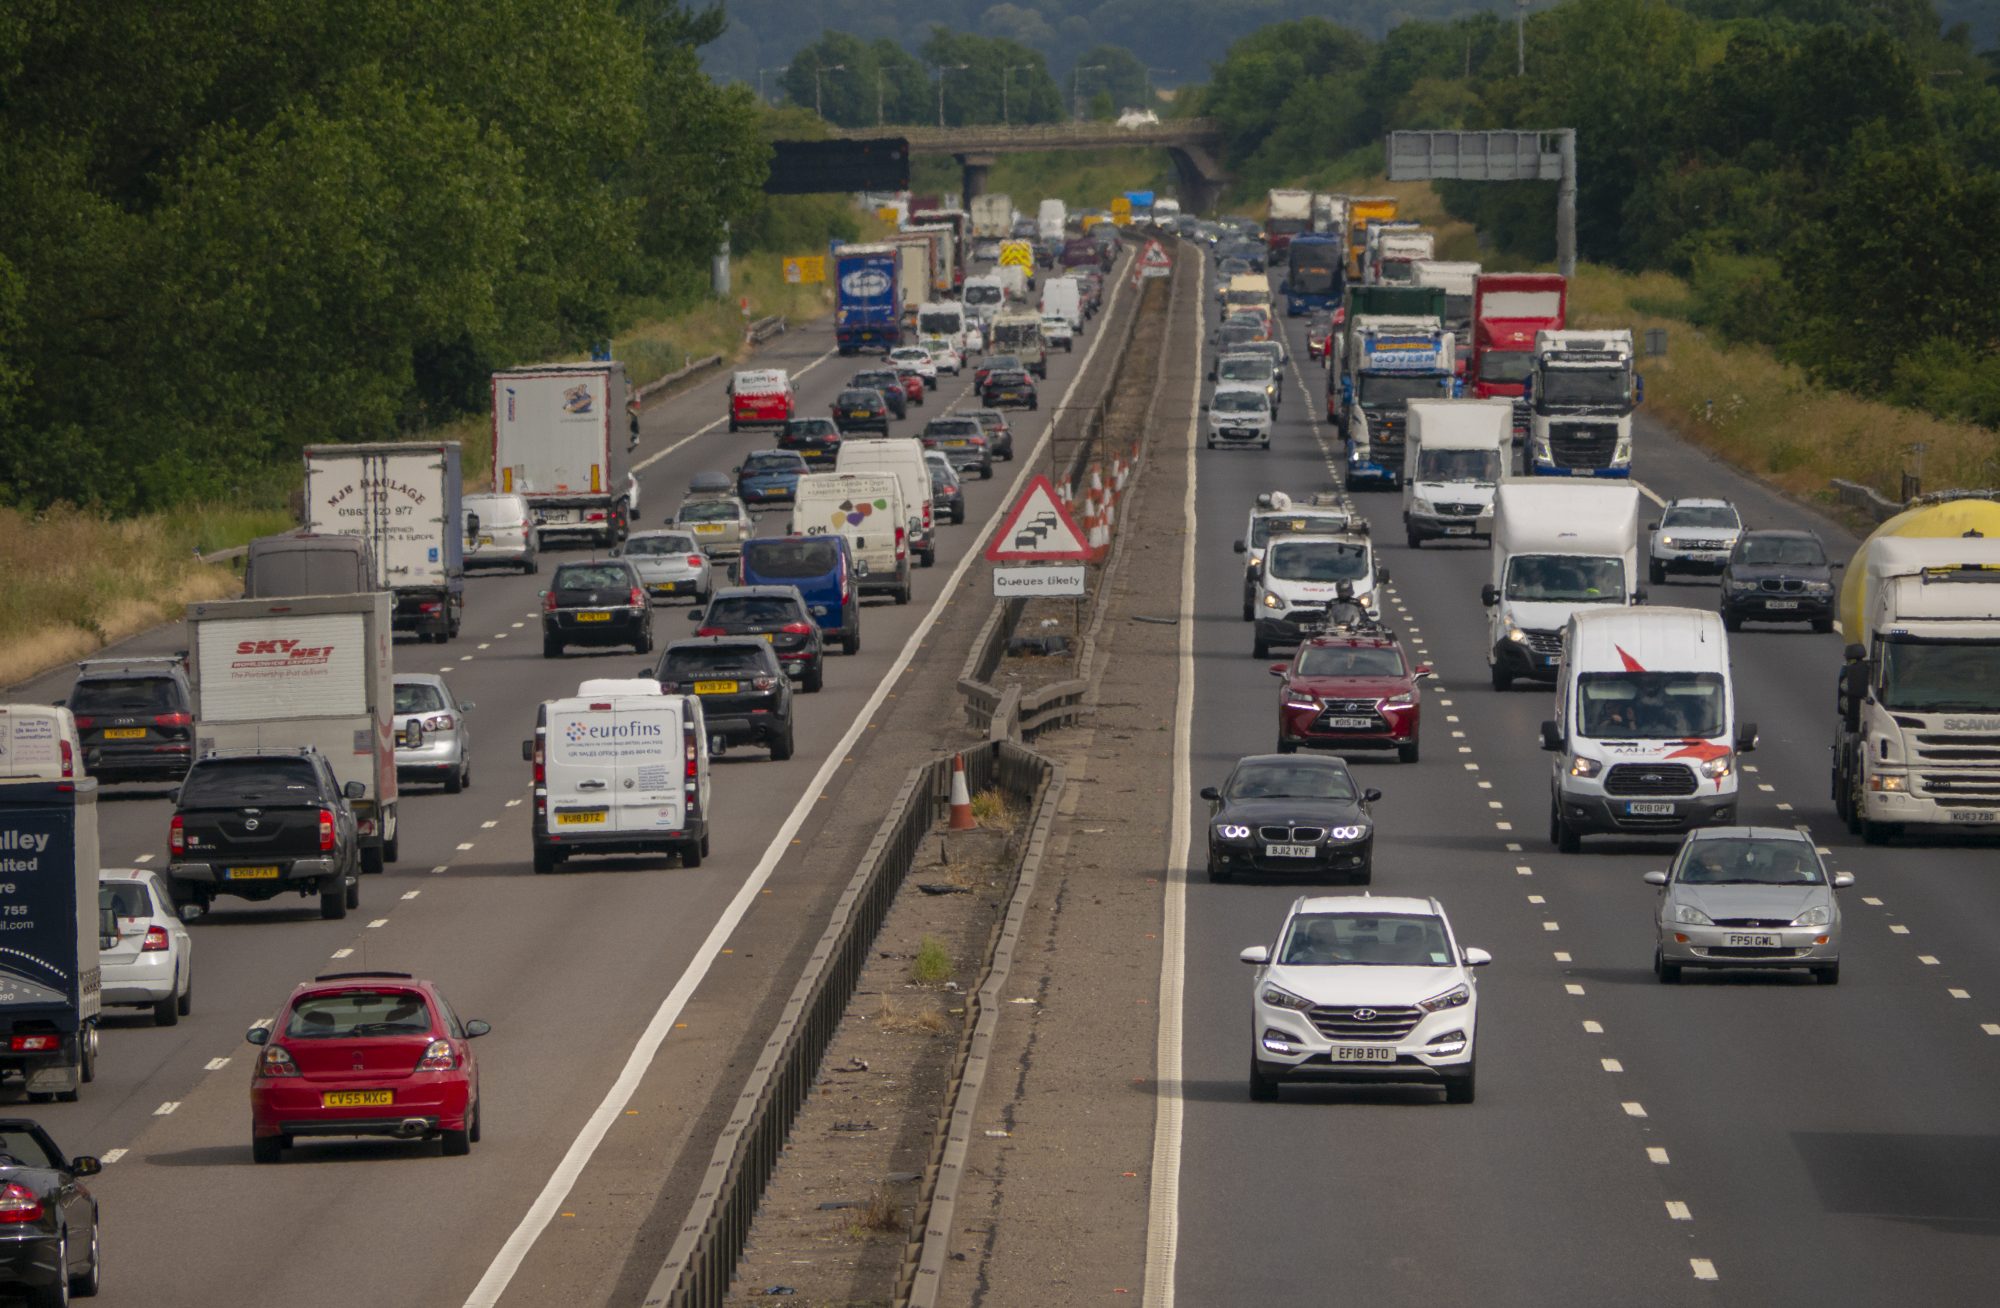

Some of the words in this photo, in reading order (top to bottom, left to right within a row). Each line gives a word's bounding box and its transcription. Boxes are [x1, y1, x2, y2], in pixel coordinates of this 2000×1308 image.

[328, 484, 354, 507] MJB
[360, 478, 426, 506] HAULAGE
[395, 506, 413, 516] 977
[997, 576, 1043, 586] Queues
[1047, 575, 1080, 586] likely
[236, 639, 300, 654] SKY
[289, 646, 334, 660] NET
[590, 721, 661, 739] eurofins
[1271, 846, 1290, 855] BJ12
[1293, 847, 1310, 856] VKF
[3, 905, 28, 915] 755
[0, 920, 34, 930] il.com
[1730, 935, 1753, 946] FP51
[1754, 936, 1774, 946] GWL
[1339, 1047, 1364, 1059] EF18
[330, 1094, 360, 1105] CV55
[363, 1091, 388, 1104] MXG
